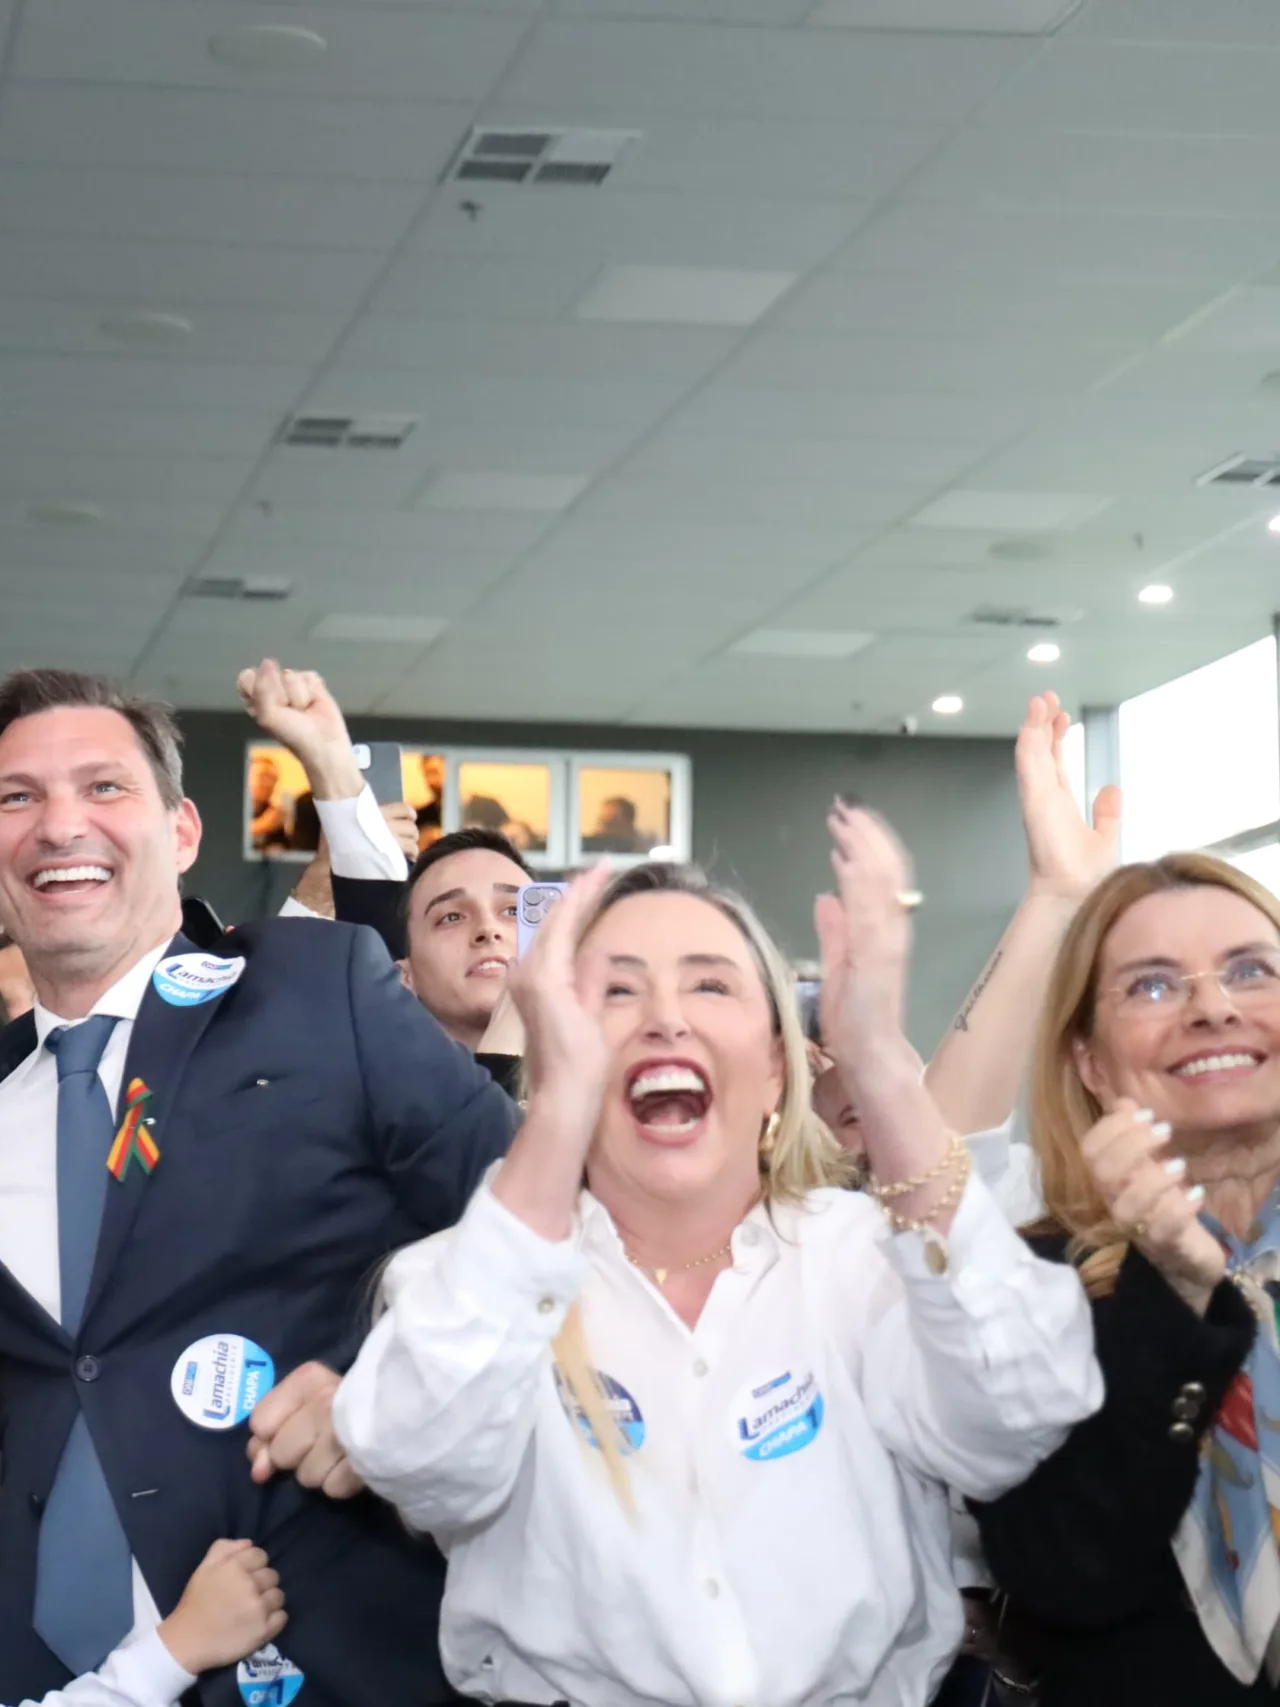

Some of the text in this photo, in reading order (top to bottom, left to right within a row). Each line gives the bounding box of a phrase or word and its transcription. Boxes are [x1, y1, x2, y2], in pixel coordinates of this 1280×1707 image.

[202, 1341, 231, 1421] Lamachia
[243, 1358, 268, 1410] CHAPA 1
